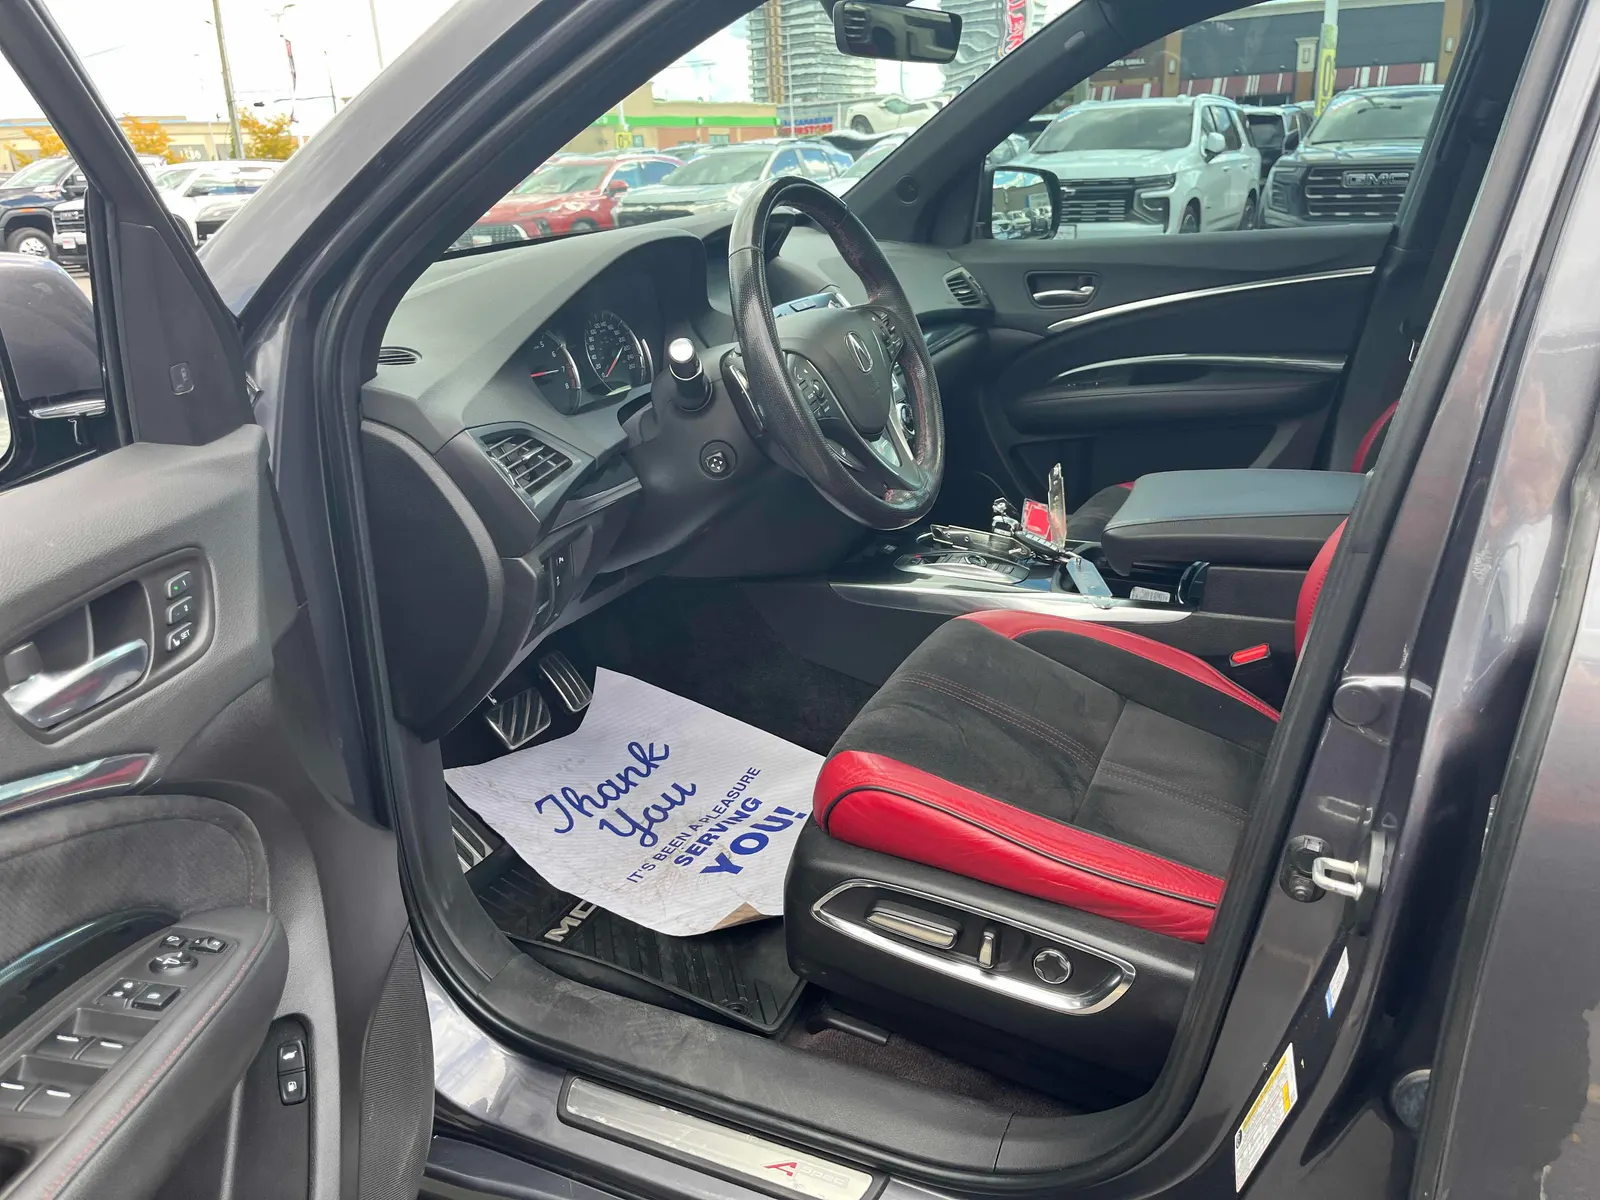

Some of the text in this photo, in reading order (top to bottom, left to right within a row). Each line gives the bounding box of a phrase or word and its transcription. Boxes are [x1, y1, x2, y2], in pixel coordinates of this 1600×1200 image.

[1346, 172, 1409, 185] GMC
[180, 629, 190, 640] SET
[534, 741, 670, 834] Thank
[599, 782, 697, 848] You
[626, 766, 761, 884] IT'S BEEN A PLEASURE
[674, 797, 763, 867] SERVING
[700, 806, 807, 875] YOU!
[544, 899, 598, 942] MD
